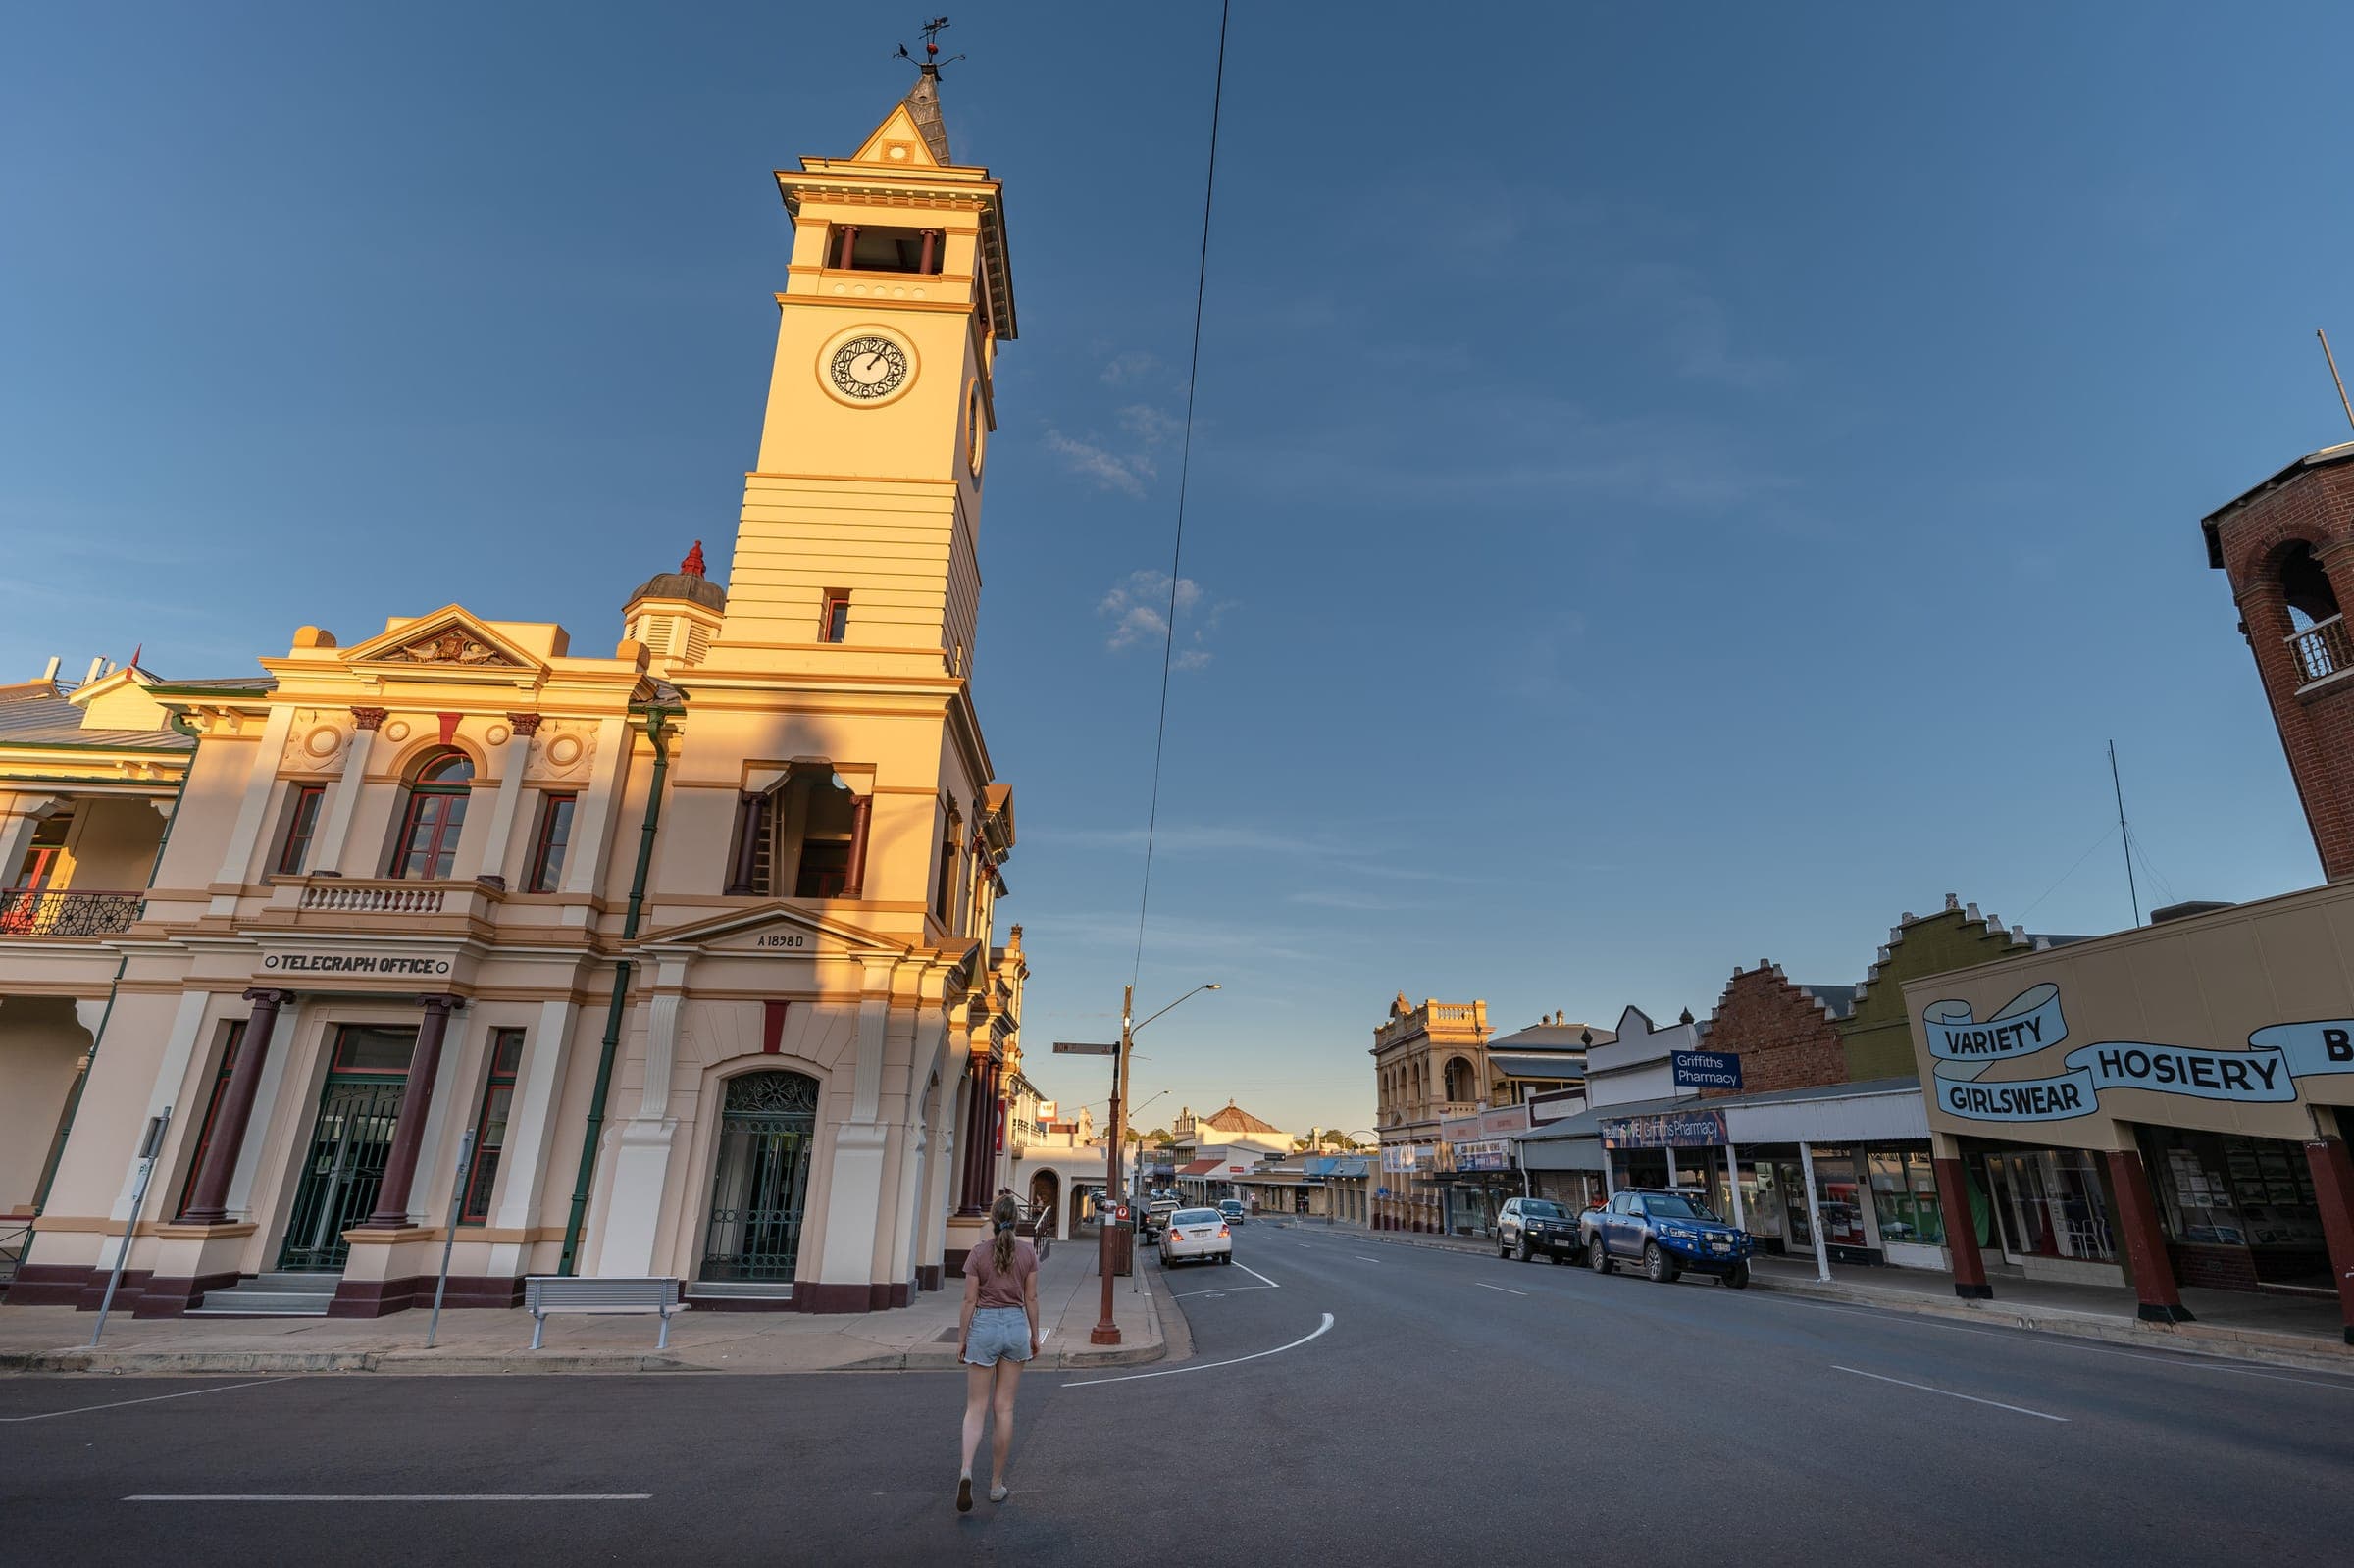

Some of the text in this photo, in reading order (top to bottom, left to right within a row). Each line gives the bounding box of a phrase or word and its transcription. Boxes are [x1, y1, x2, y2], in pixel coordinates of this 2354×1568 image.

[757, 935, 803, 948] A 1898 D
[281, 955, 435, 974] TELEGRAPH OFFICE
[1944, 1015, 2041, 1055] VARIETY
[1677, 1055, 1724, 1069] Griffiths
[2098, 1049, 2277, 1091] HOSIERY
[1678, 1069, 1737, 1087] Pharmacy
[1949, 1083, 2082, 1115] GIRLSWEAR
[1674, 1120, 1718, 1138] Pharmacy
